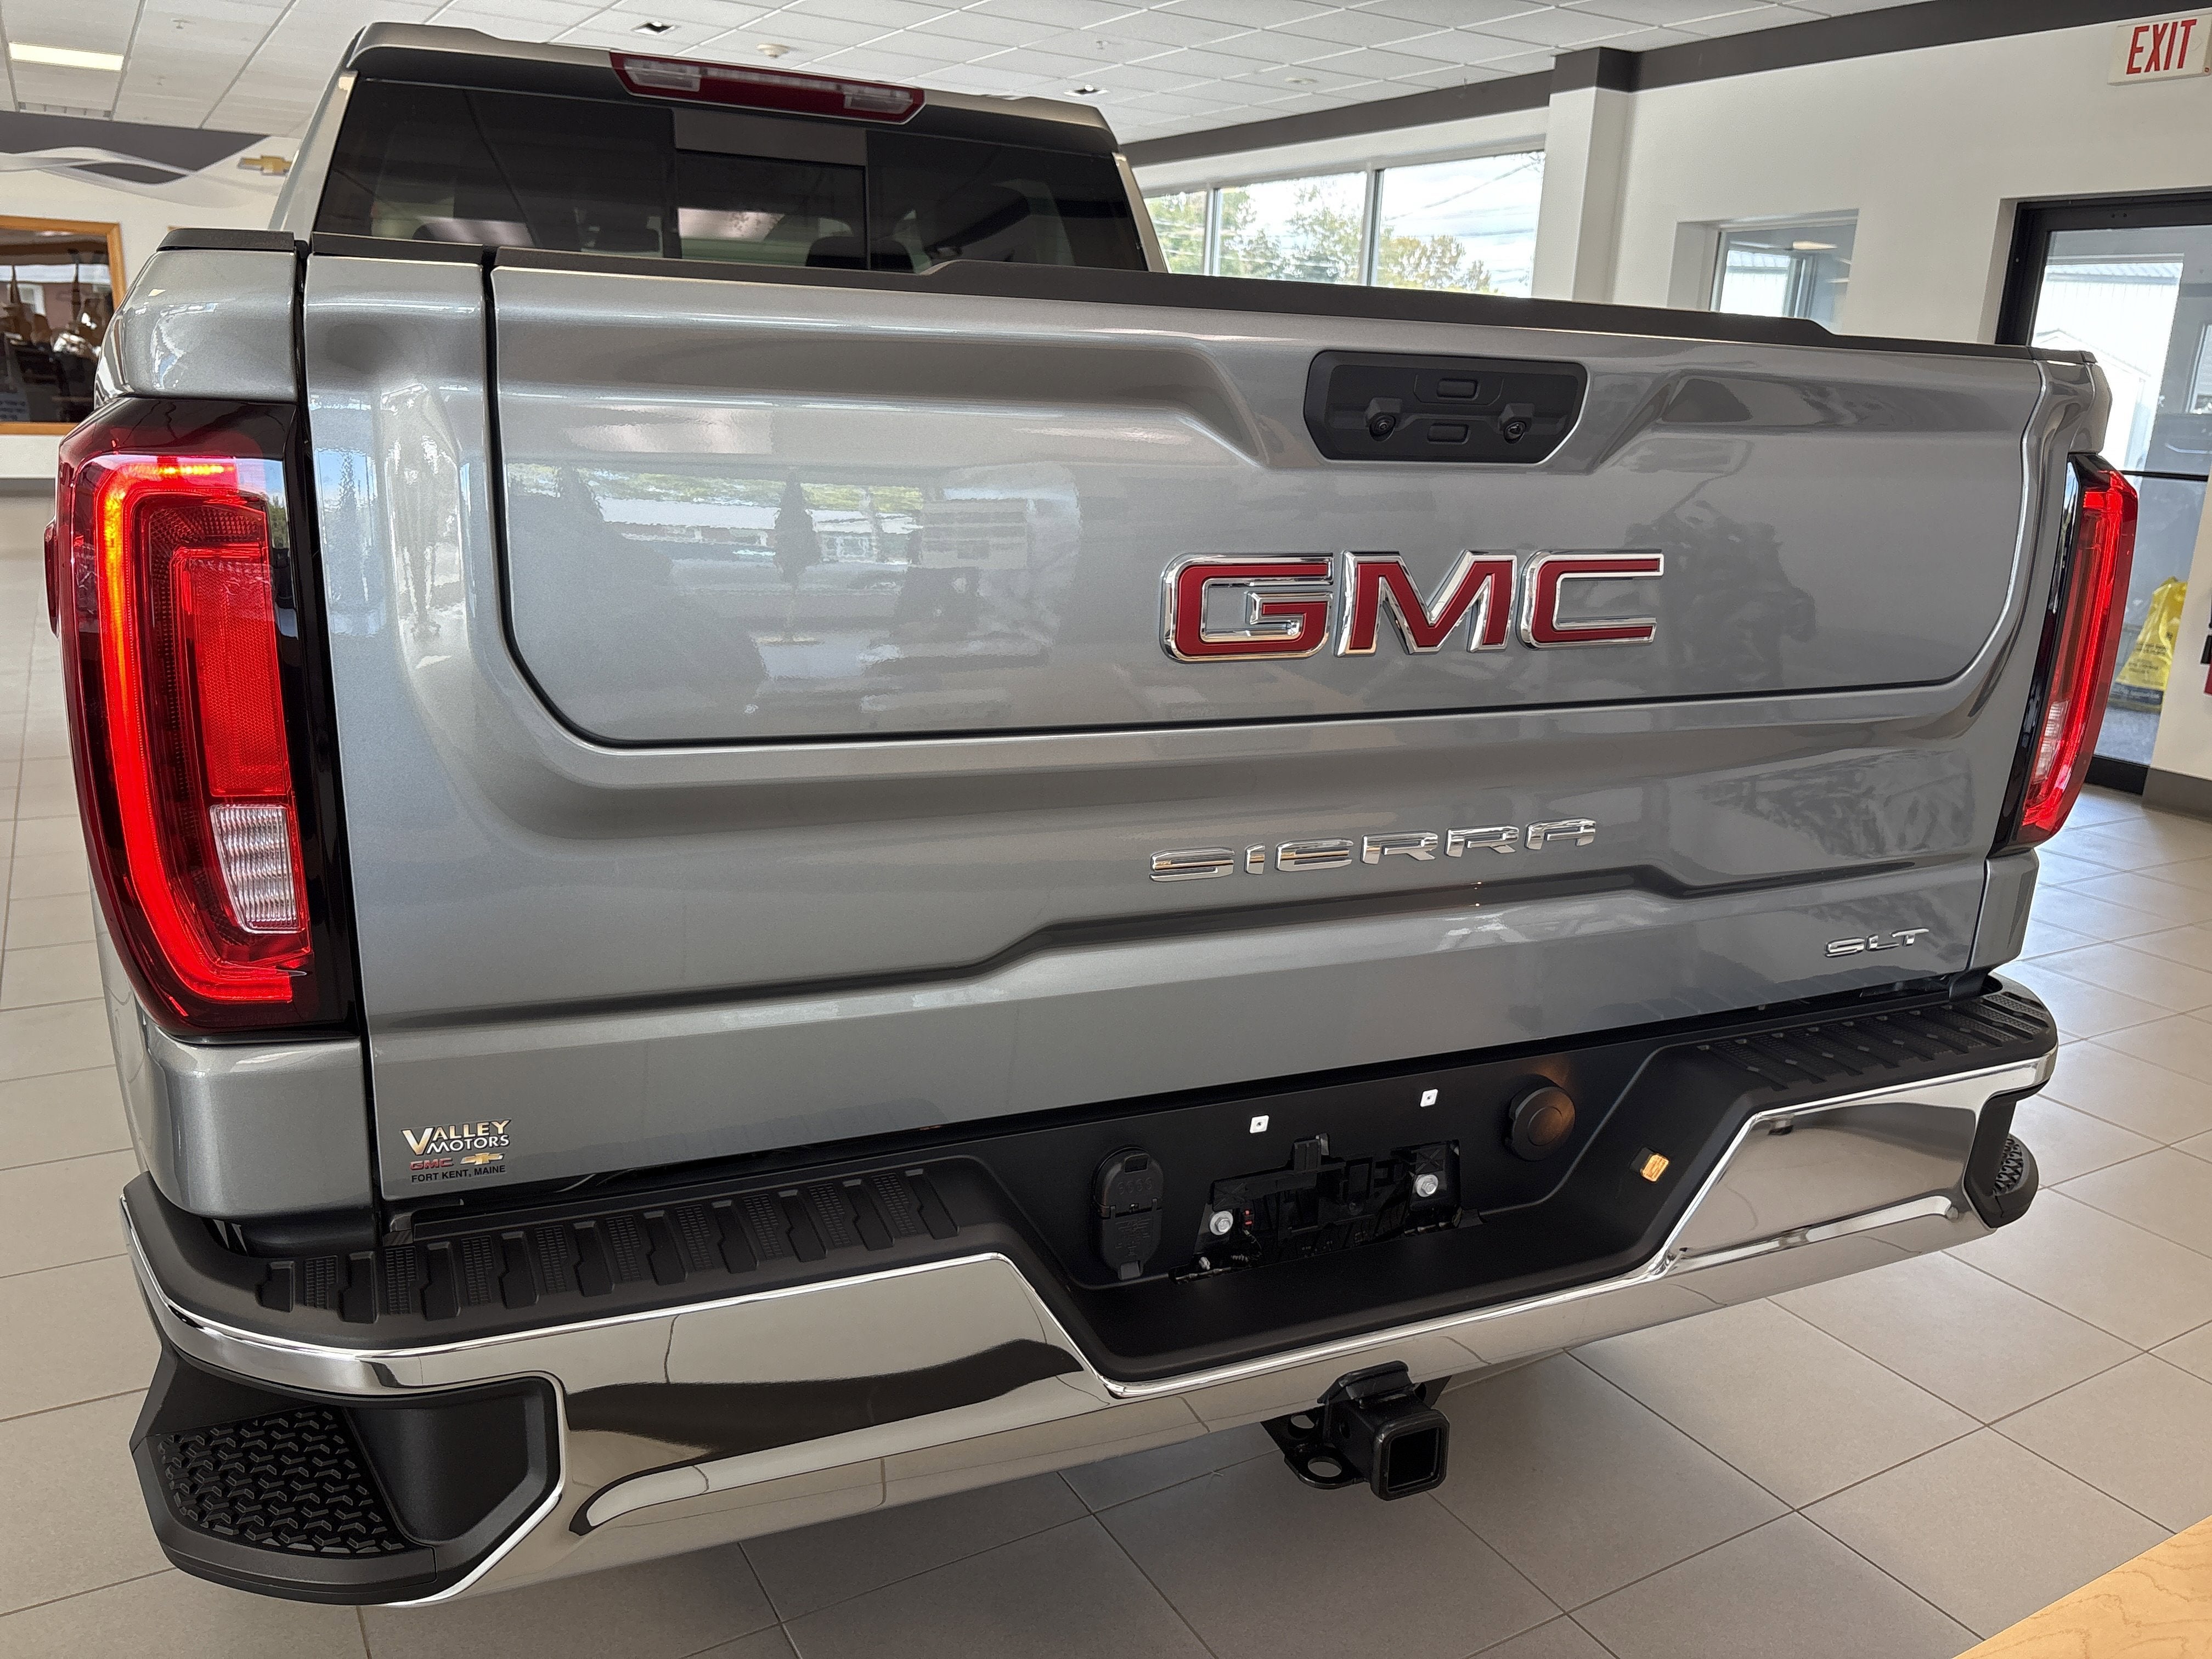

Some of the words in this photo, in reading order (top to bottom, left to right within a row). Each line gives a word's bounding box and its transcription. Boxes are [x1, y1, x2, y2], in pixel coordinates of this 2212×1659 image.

[2126, 19, 2197, 75] EXIT
[1160, 550, 1663, 662] GMC
[1149, 817, 1597, 882] SIERRA
[1825, 927, 1929, 957] SLT
[401, 1119, 511, 1155] VALLEY
[427, 1135, 510, 1154] MOTORS
[410, 1157, 454, 1170] GMC
[411, 1172, 439, 1183] FORT
[442, 1169, 471, 1179] KENT,
[474, 1165, 506, 1176] MAINE
